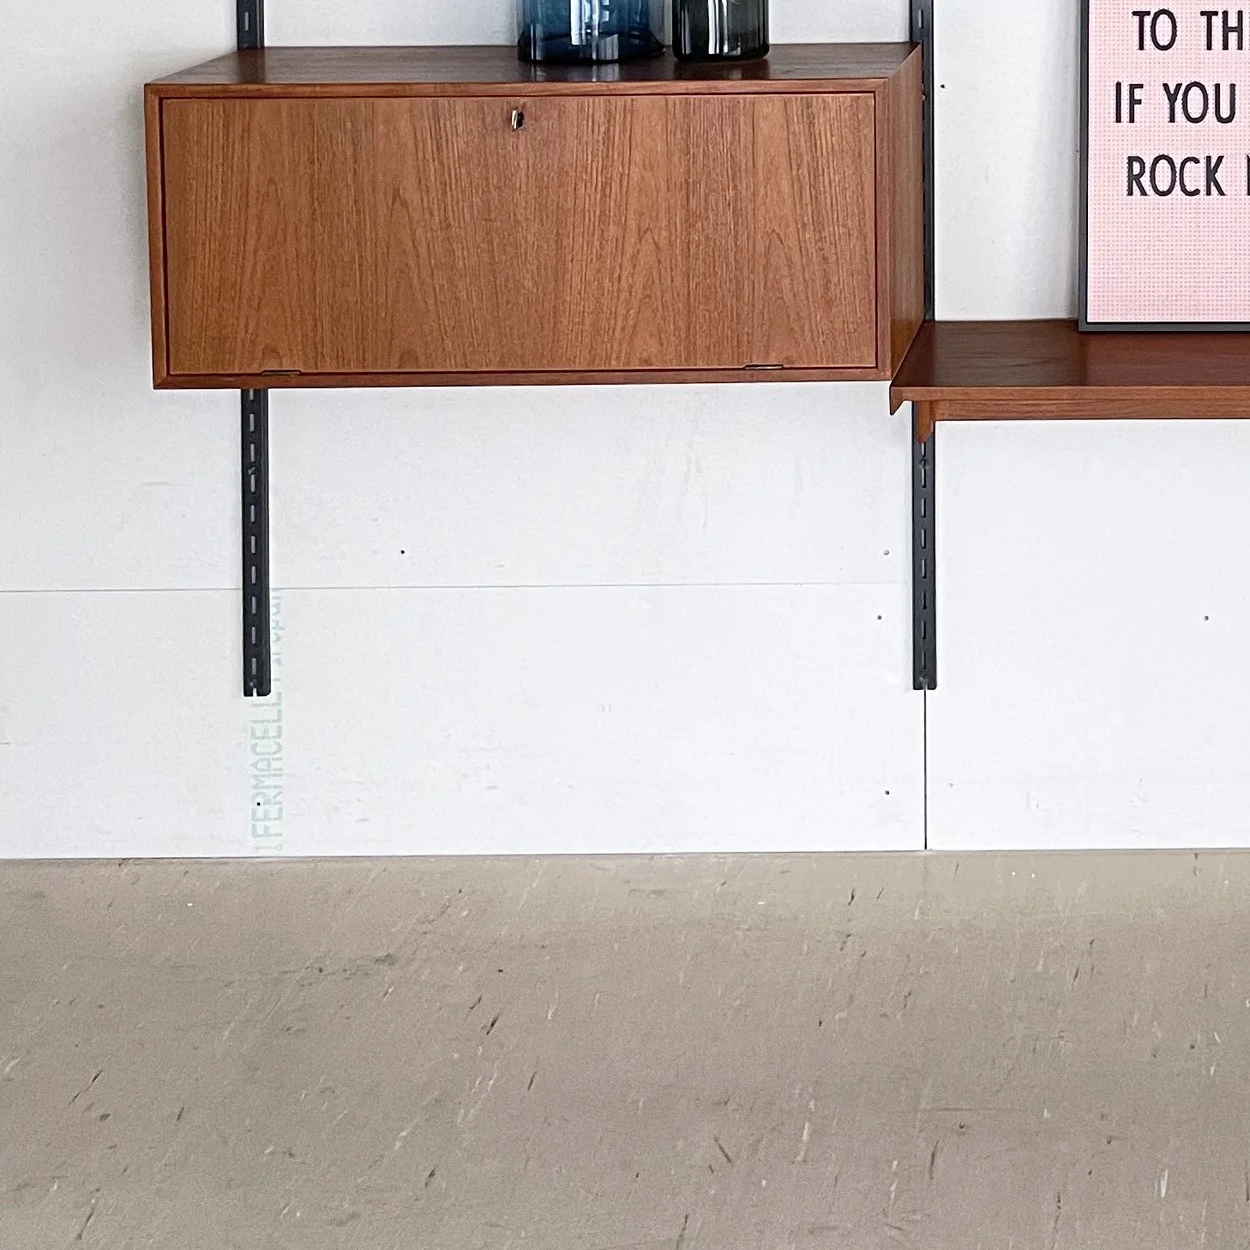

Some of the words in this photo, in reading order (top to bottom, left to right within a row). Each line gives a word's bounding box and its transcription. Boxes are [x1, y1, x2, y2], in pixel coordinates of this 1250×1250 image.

[1131, 9, 1178, 51] TO
[1115, 81, 1144, 123] IF
[1162, 81, 1237, 123] YOU
[1126, 154, 1226, 196] ROCK
[251, 692, 284, 839] FERMACELL
